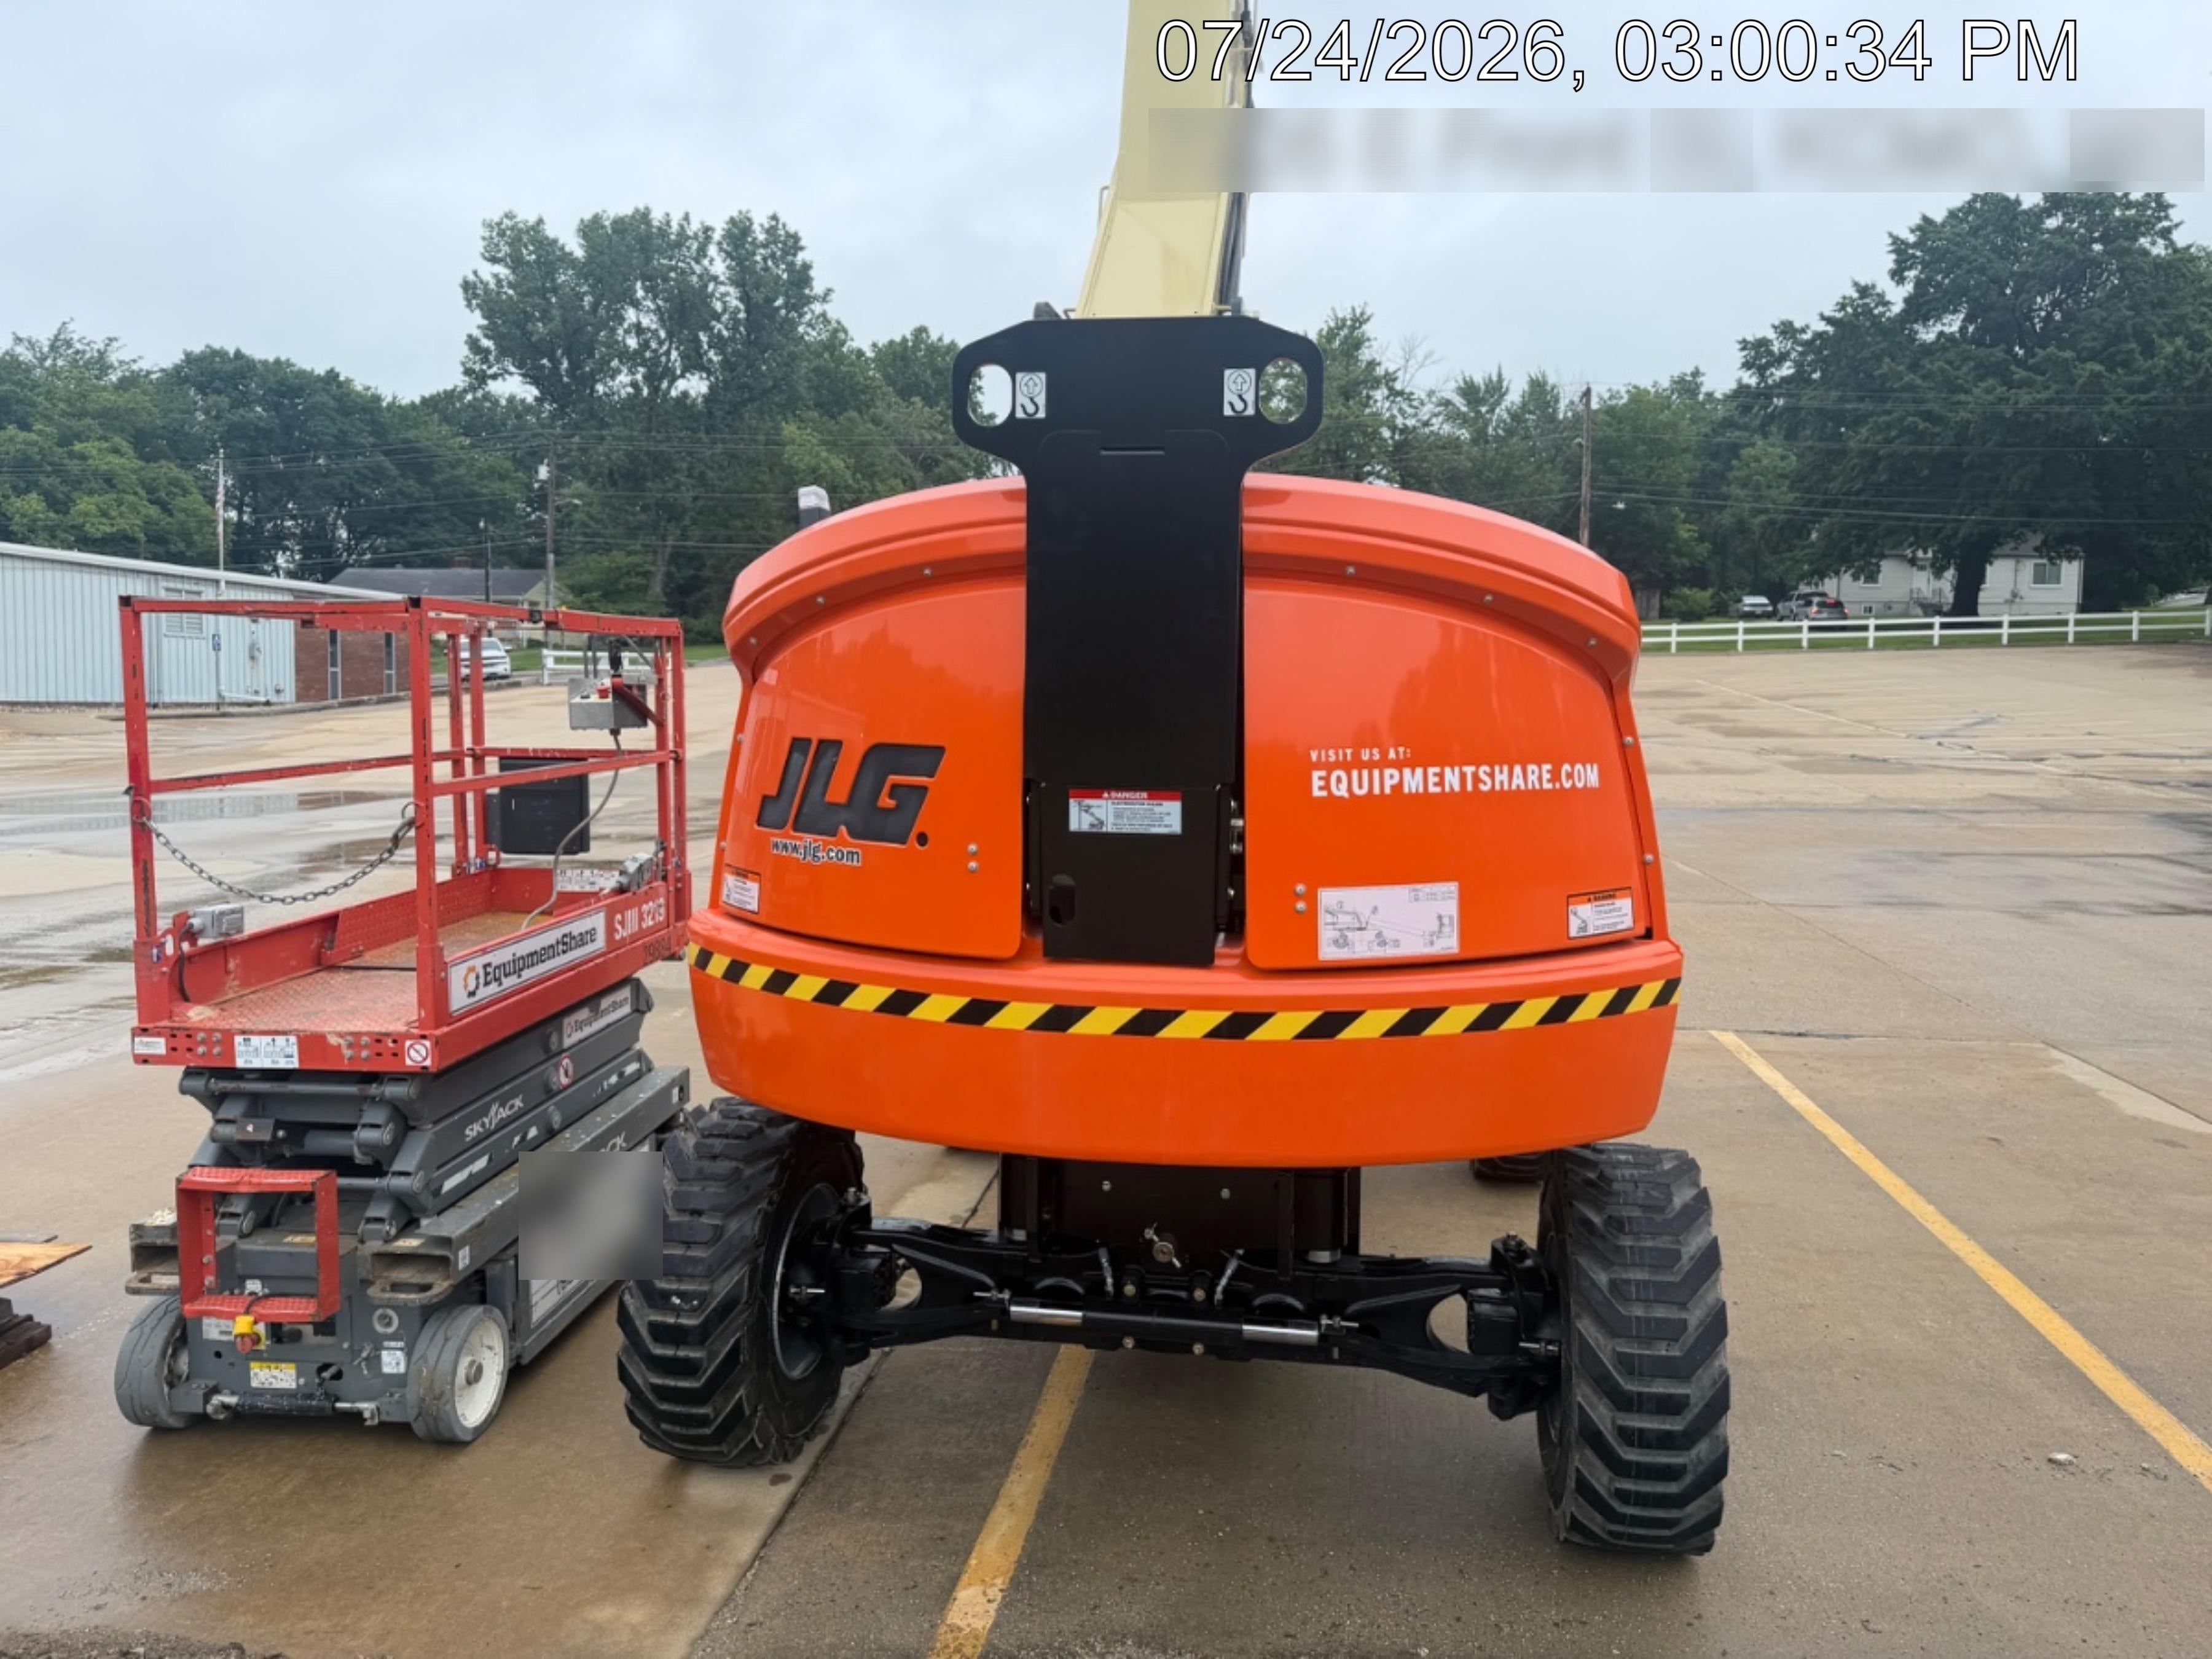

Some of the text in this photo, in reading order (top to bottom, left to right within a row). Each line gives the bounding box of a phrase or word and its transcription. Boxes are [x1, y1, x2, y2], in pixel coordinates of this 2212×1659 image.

[1310, 746, 1411, 763] VISIT US AT:
[756, 737, 945, 845] JLG
[1311, 763, 1599, 799] EQUIPMENTSHARE.COM
[771, 837, 861, 865] www.jlg.com
[482, 927, 597, 987] EquipmentShare
[465, 1094, 524, 1142] SKYJACK
